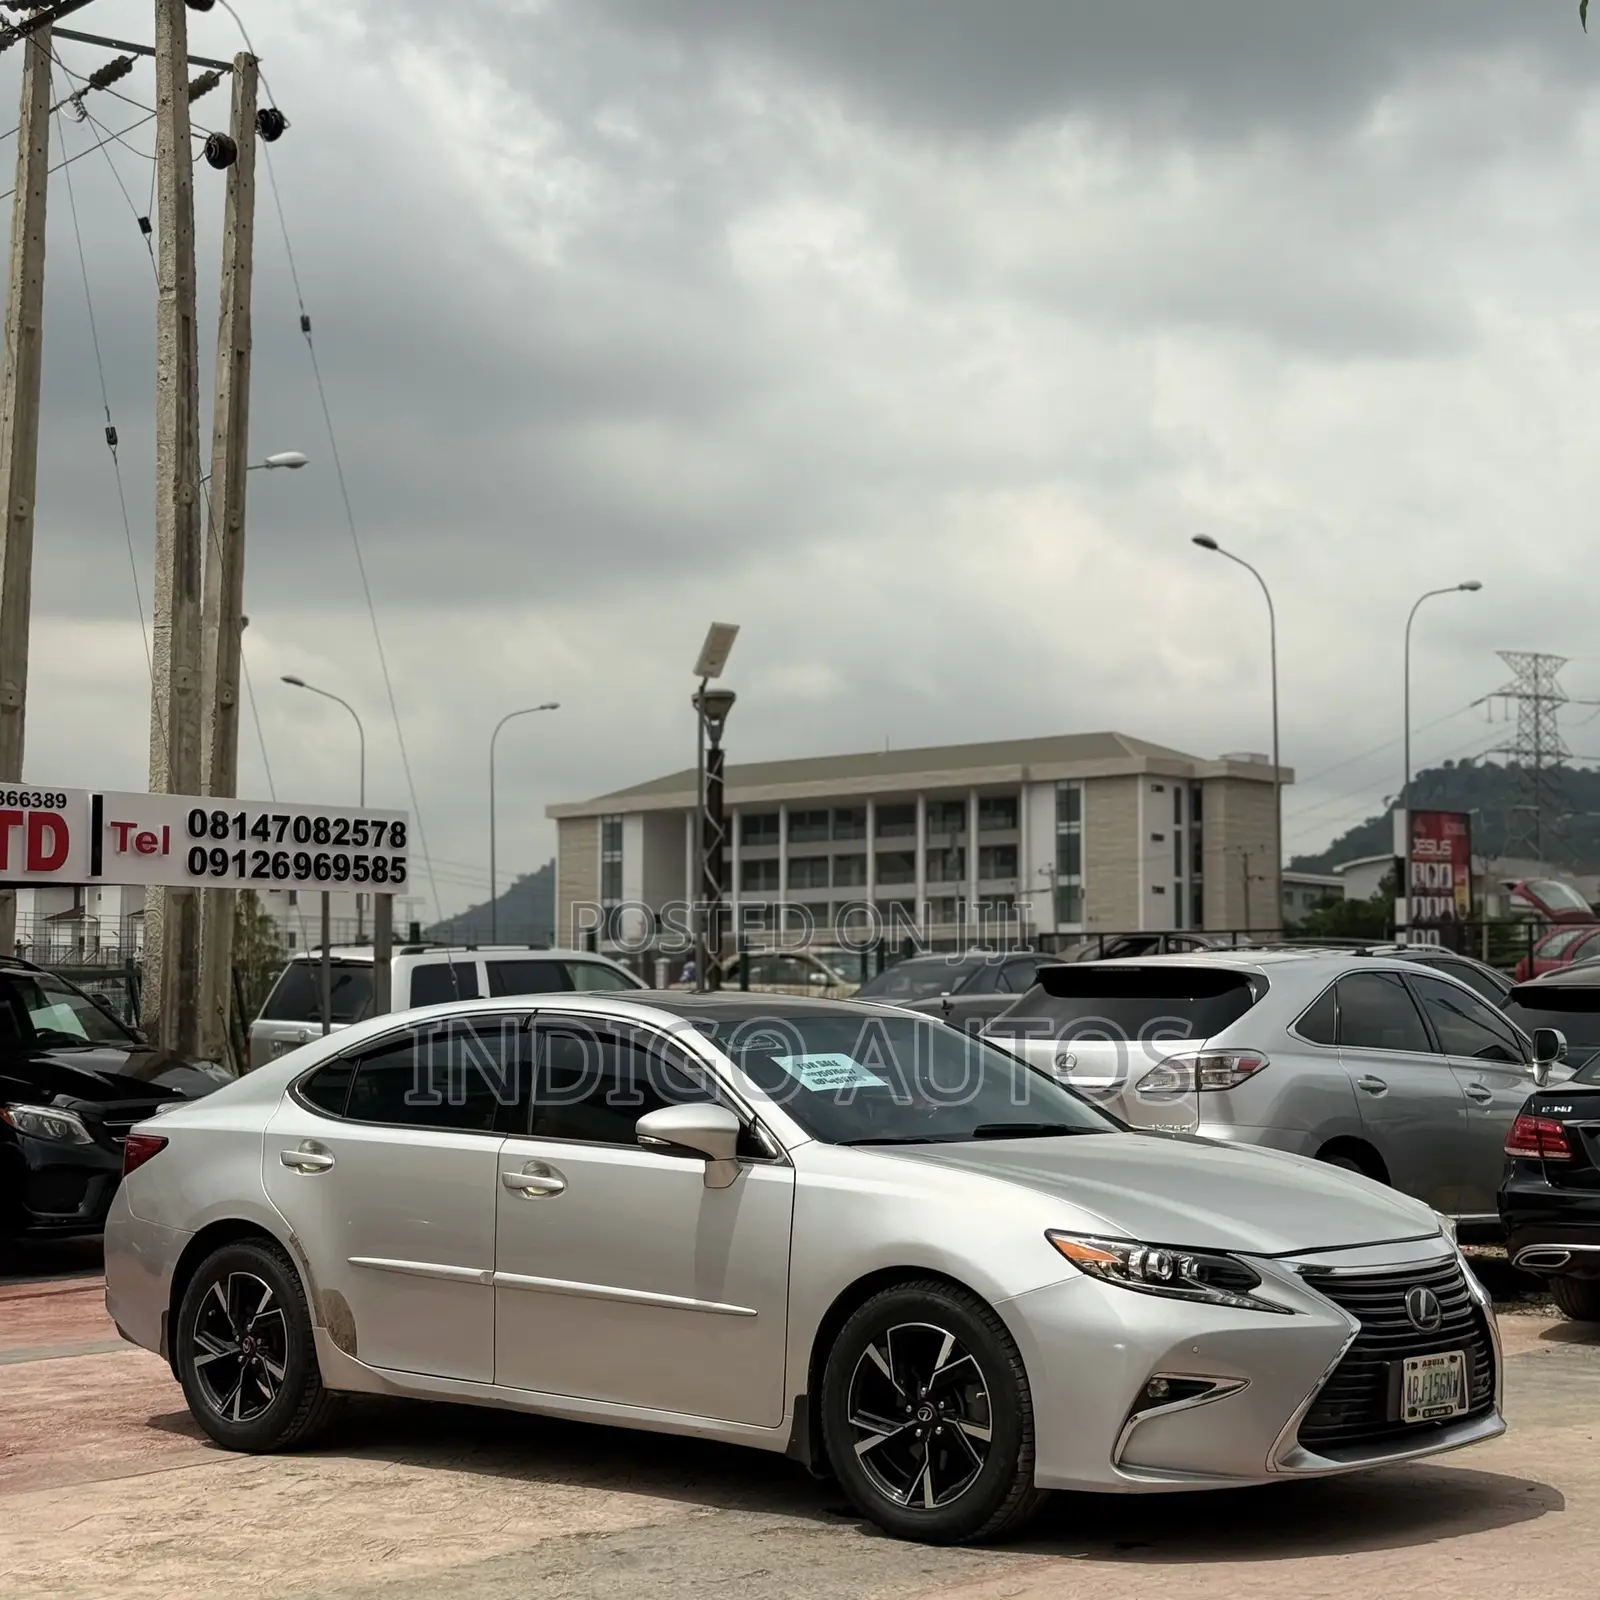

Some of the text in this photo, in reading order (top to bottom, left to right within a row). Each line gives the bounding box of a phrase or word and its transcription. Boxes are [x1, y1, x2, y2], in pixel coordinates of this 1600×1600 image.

[110, 820, 170, 855] Tel
[187, 808, 407, 849] 08147082578
[187, 846, 407, 884] 09126969585
[796, 1062, 818, 1071] FOR
